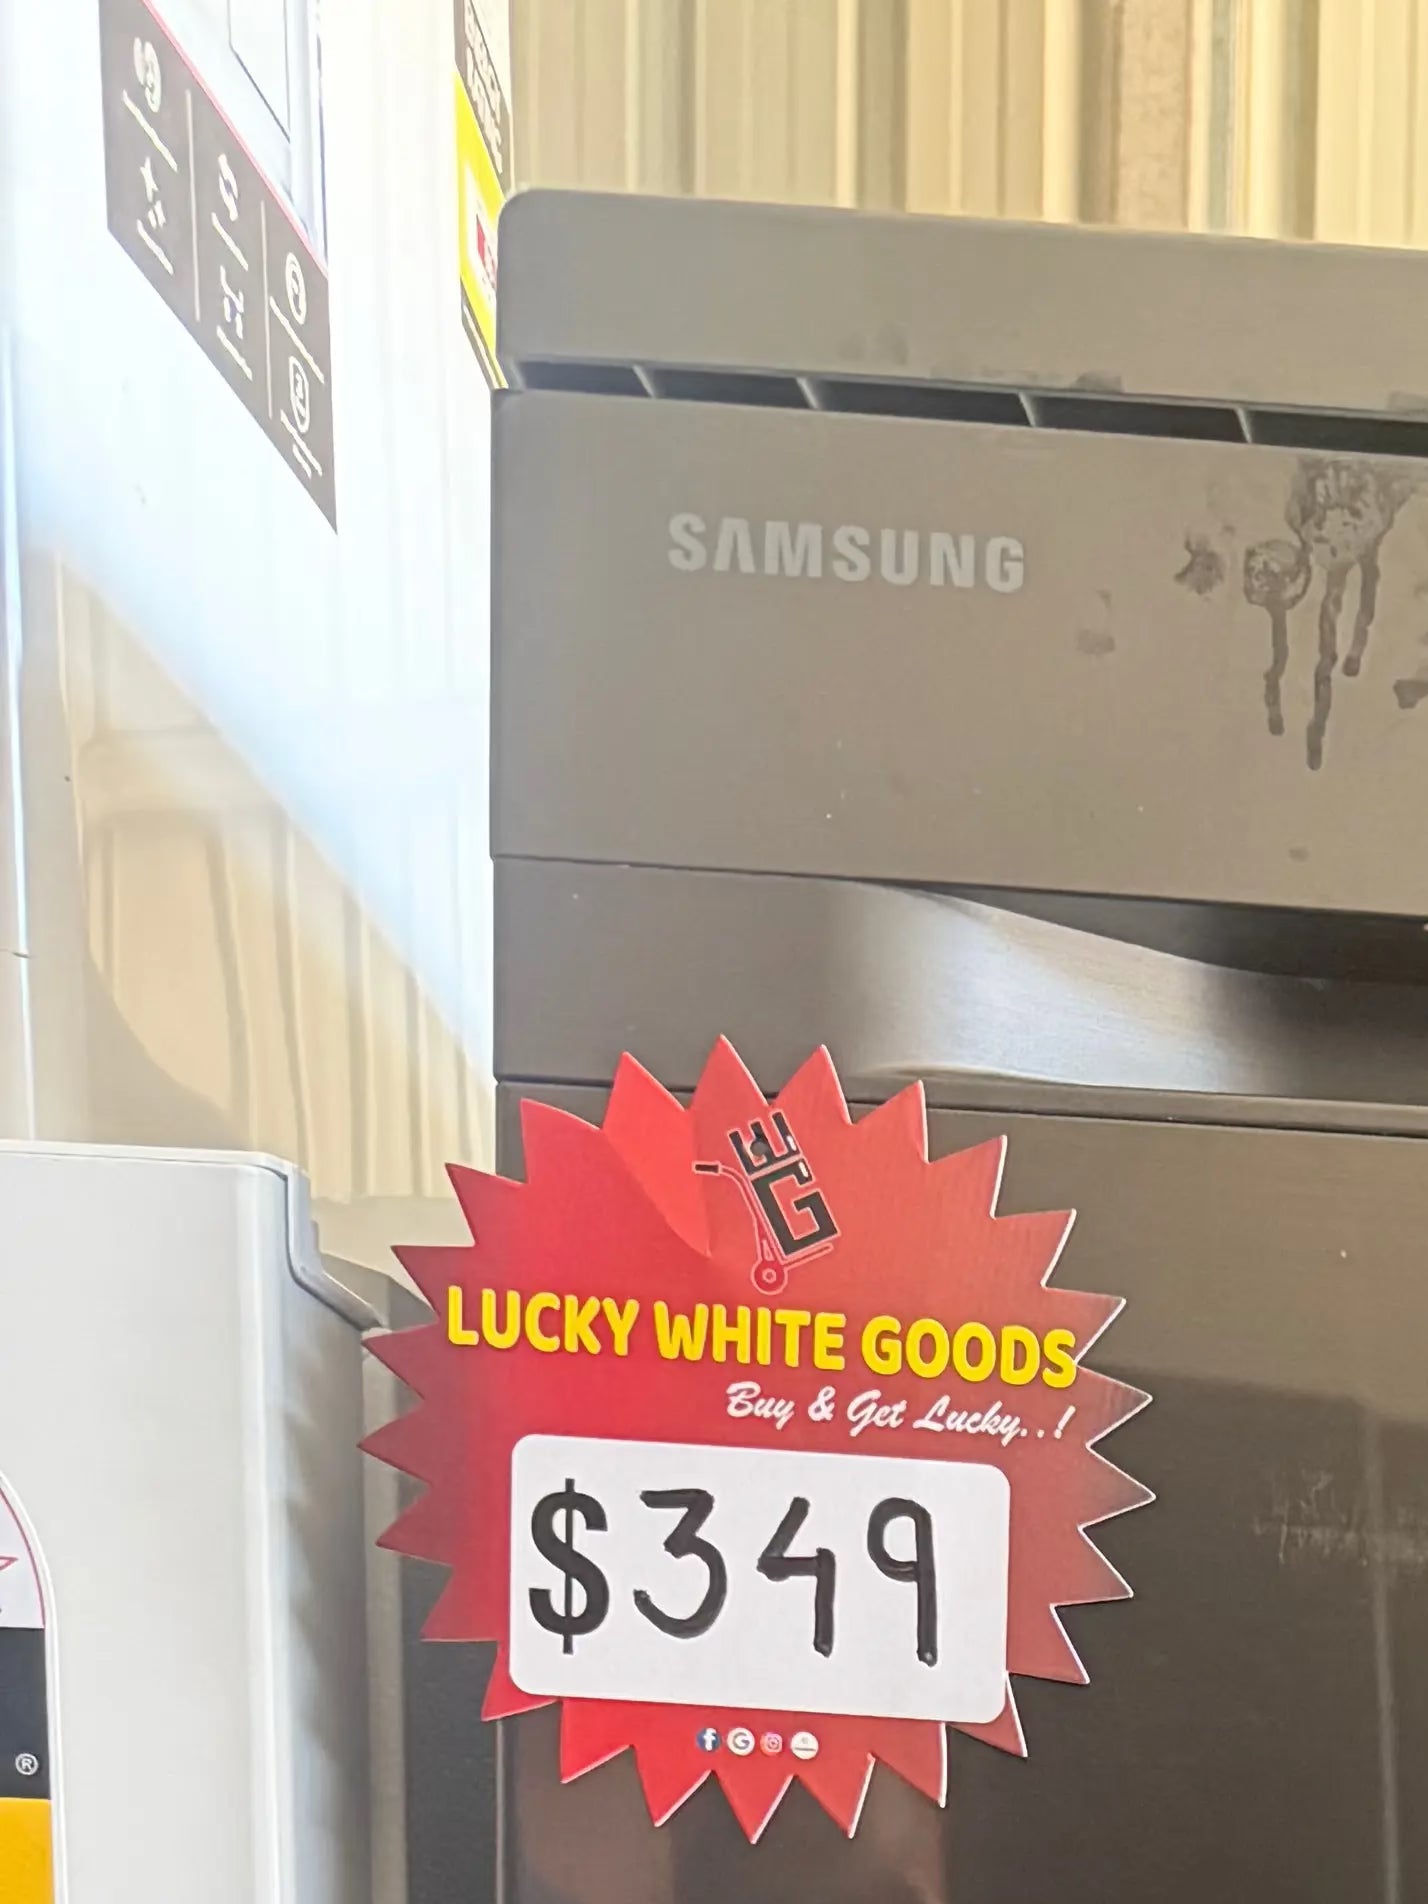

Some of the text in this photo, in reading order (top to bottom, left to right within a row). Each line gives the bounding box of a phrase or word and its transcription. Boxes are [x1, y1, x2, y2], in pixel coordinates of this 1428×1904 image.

[667, 511, 1026, 593] SAMSUNG
[447, 1285, 1078, 1388] LUCKY WHITE GOODS
[725, 1380, 797, 1431] Buy
[807, 1385, 837, 1422] &
[846, 1388, 908, 1438] Get
[528, 1477, 938, 1668] $349
